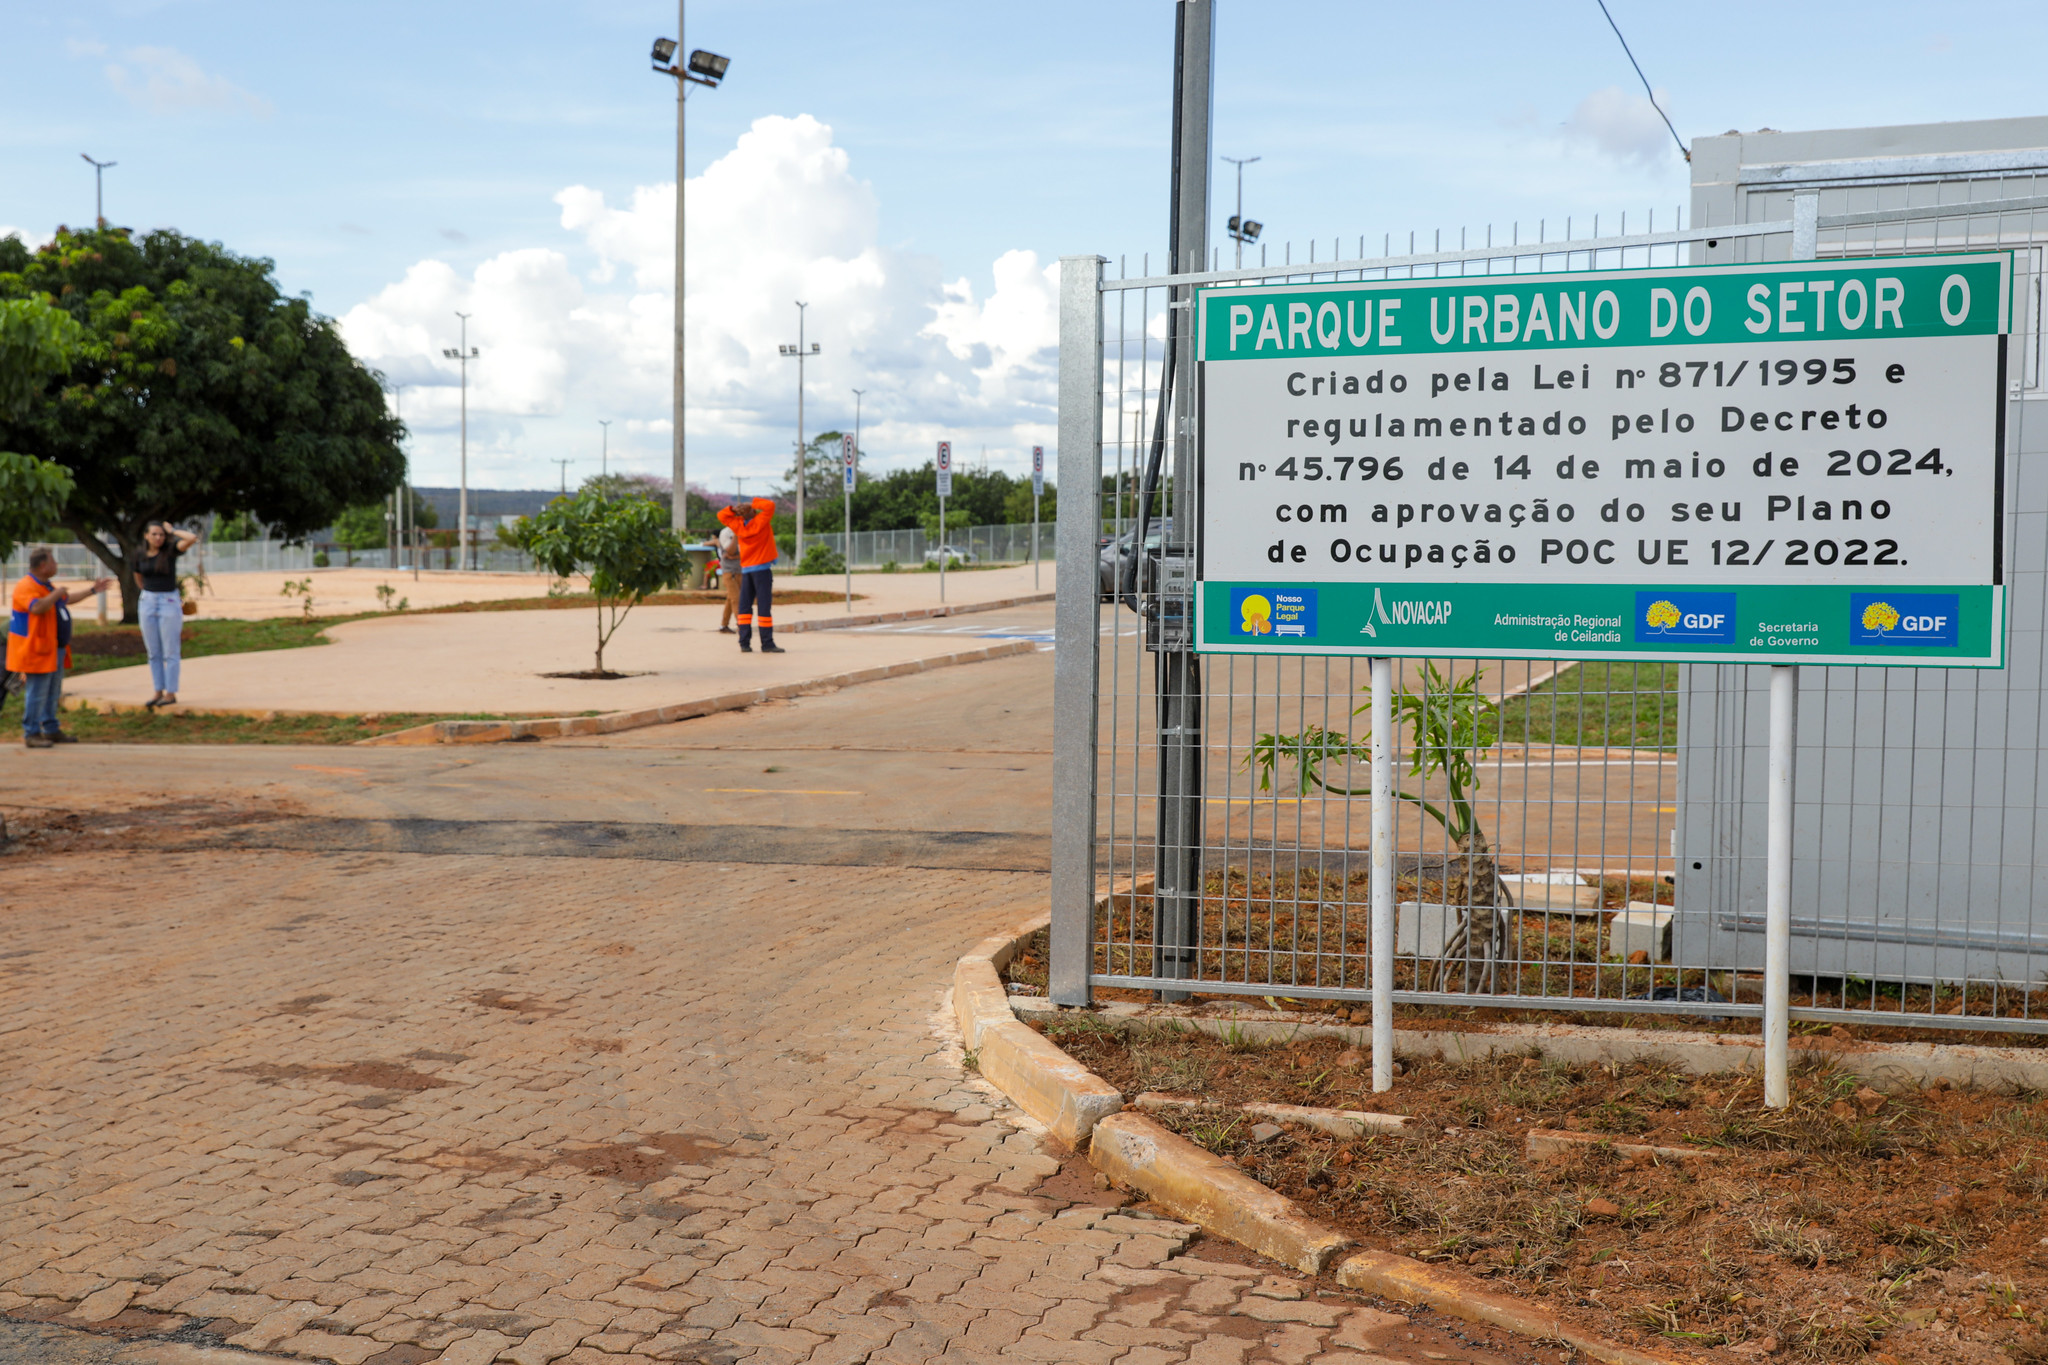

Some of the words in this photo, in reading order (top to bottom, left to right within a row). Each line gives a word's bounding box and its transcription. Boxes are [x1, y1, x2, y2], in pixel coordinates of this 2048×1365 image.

[1230, 298, 1401, 351] PARQUE
[1431, 290, 1619, 344] URBANO
[1651, 286, 1711, 337] DO
[1744, 276, 1904, 333] SETOR
[1940, 274, 1970, 326] O
[1287, 370, 1407, 396] Criado
[1432, 367, 1508, 398] pela
[1535, 364, 1588, 389] Lei
[1659, 358, 1856, 387] 871/1995
[1886, 364, 1905, 383] e
[1288, 411, 1586, 445] regulamentado
[1612, 408, 1694, 440] pelo
[1722, 404, 1887, 432] Decreto
[1275, 457, 1403, 480] 45.796
[1428, 457, 1469, 480] de
[1495, 455, 1531, 479] 14
[1557, 455, 1599, 479] de
[1626, 451, 1725, 478] maio
[1753, 452, 1798, 477] de
[1827, 448, 1952, 477] 2024,
[1276, 504, 1346, 522] com
[1372, 499, 1574, 528] aprovação
[1601, 498, 1644, 522] do
[1672, 502, 1740, 522] seu
[1768, 495, 1890, 521] Plano
[1268, 540, 1306, 563] de
[1331, 539, 1515, 568] Ocupação
[1541, 539, 1614, 564] POC
[1639, 540, 1688, 565] UE
[1712, 539, 1907, 565] 12/2022.
[1276, 595, 1302, 603] Nosso
[1276, 603, 1305, 613] Parque
[1392, 601, 1452, 625] NOVACAP
[1276, 612, 1298, 621] Legal
[1494, 613, 1571, 629] Administração
[1574, 615, 1621, 629] Regional
[1683, 614, 1725, 629] GDF
[1902, 616, 1947, 632] GDF
[1758, 622, 1818, 632] Secretaria
[1555, 630, 1568, 641] de
[1571, 630, 1620, 642] Ceilandia
[1750, 636, 1764, 646] de
[1767, 636, 1819, 647] Governo
